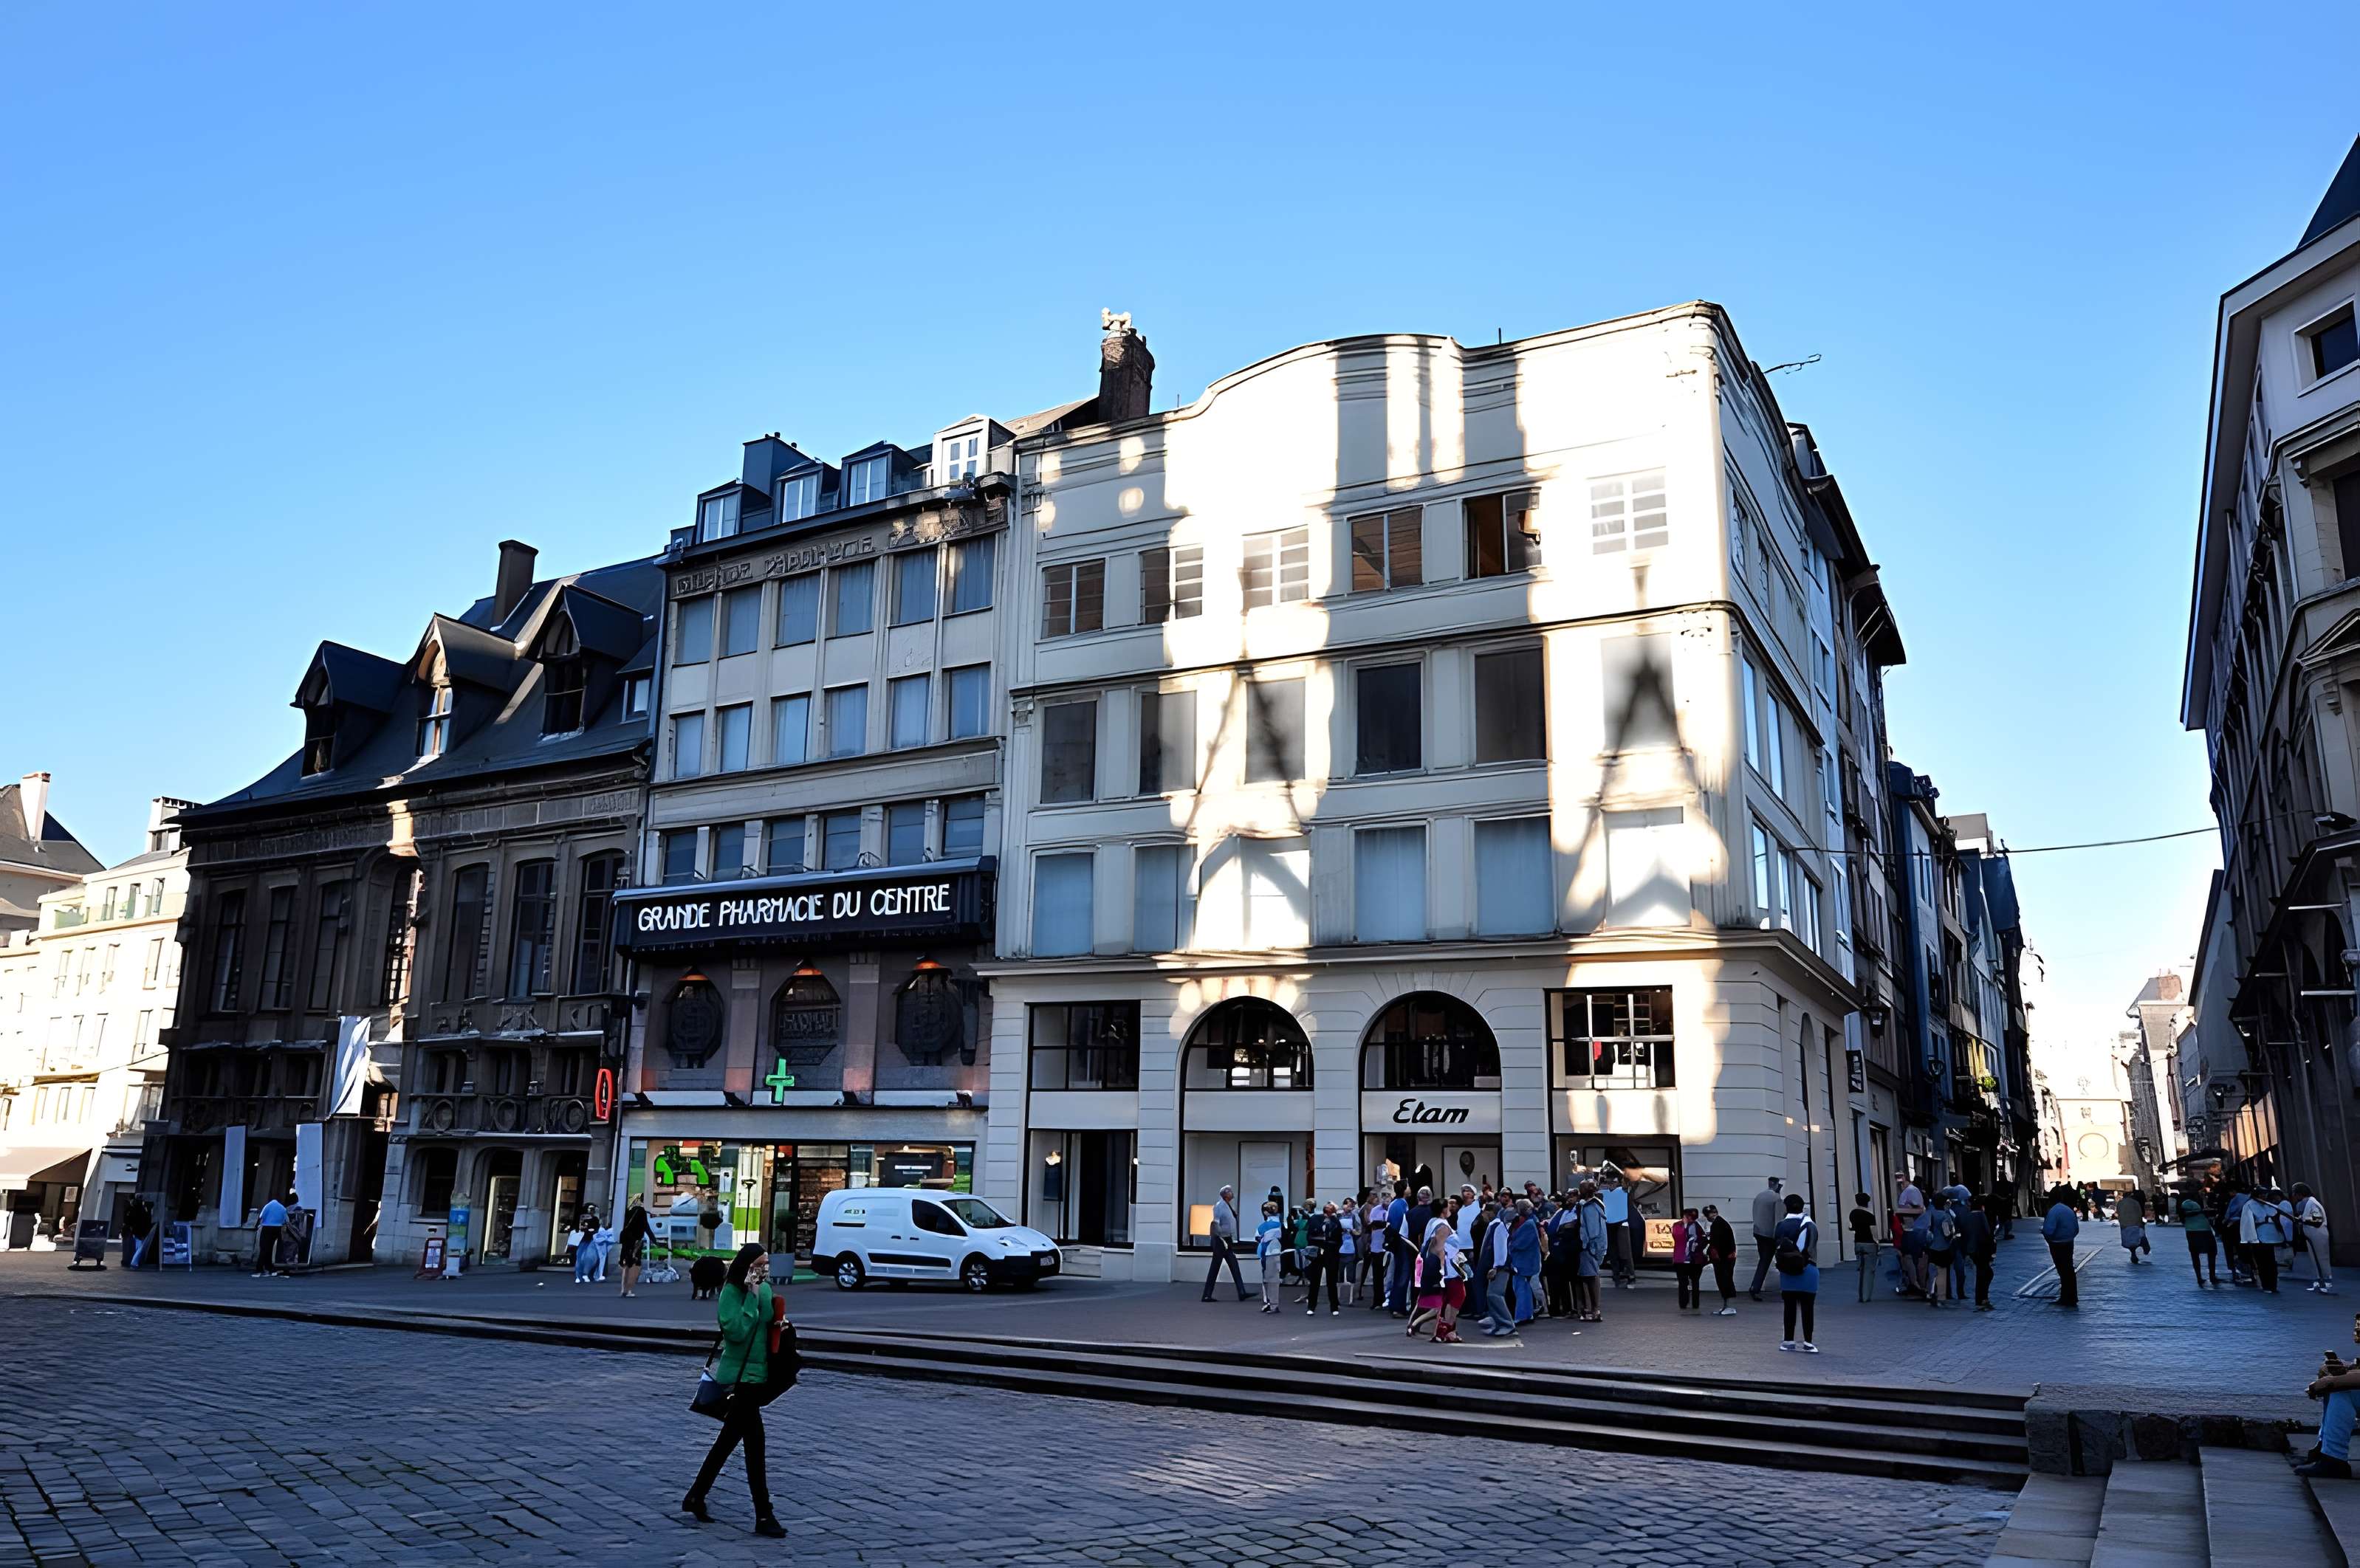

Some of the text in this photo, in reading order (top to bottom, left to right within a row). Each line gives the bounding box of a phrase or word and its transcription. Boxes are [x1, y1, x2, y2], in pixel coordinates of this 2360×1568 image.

[637, 883, 951, 932] GRANDE PHARMACIE DU CENTRE
[1393, 1098, 1469, 1124] Etam
